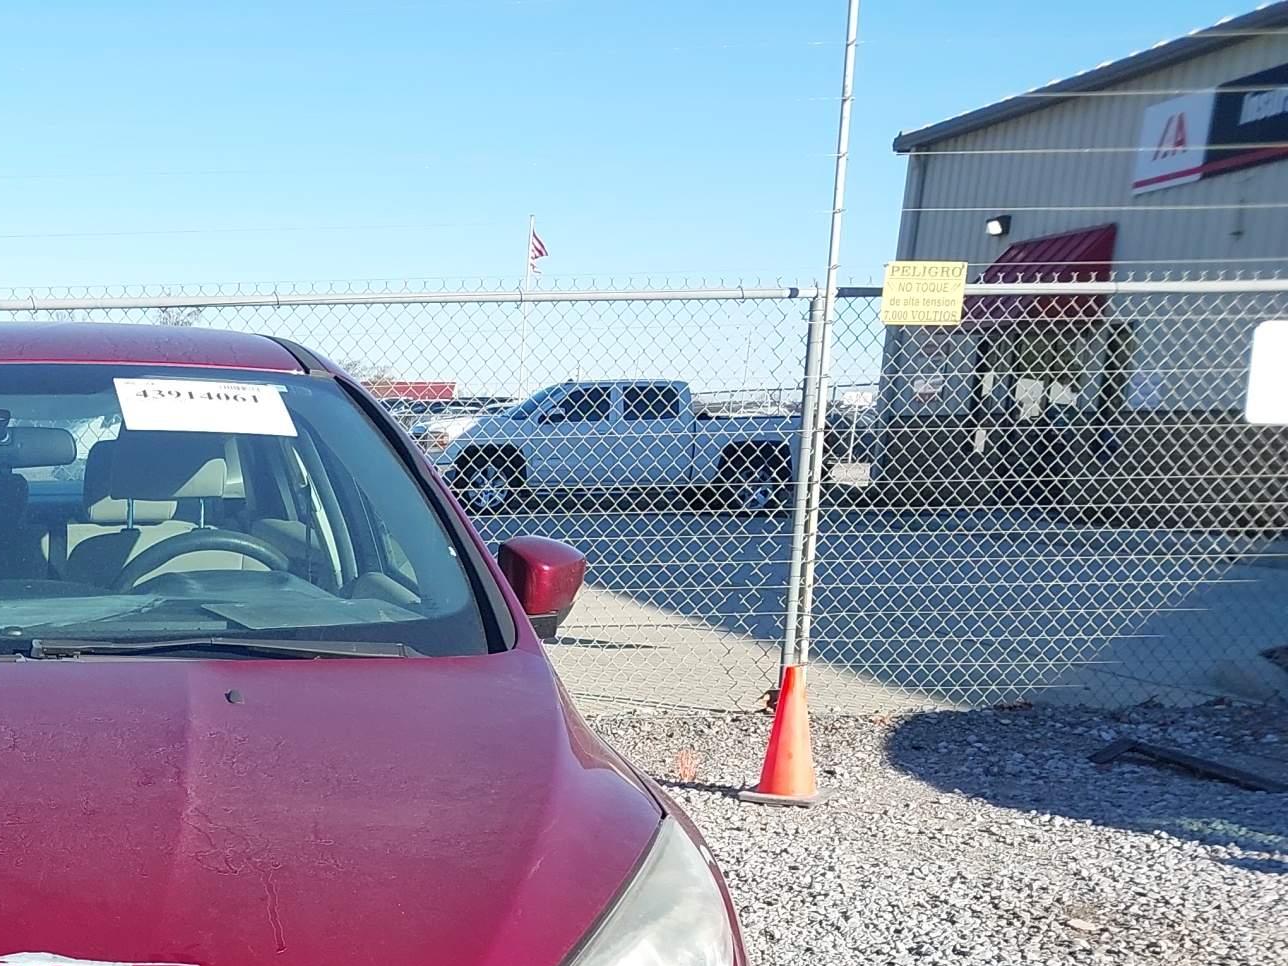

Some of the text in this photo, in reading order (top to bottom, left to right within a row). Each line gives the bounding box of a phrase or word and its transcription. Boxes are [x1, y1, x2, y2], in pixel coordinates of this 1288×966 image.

[890, 265, 962, 278] PELIGRO
[898, 282, 949, 293] NO TOQUE
[889, 297, 956, 307] de alta tension
[911, 311, 958, 321] VOLTIOS
[135, 389, 260, 403] 43914061
